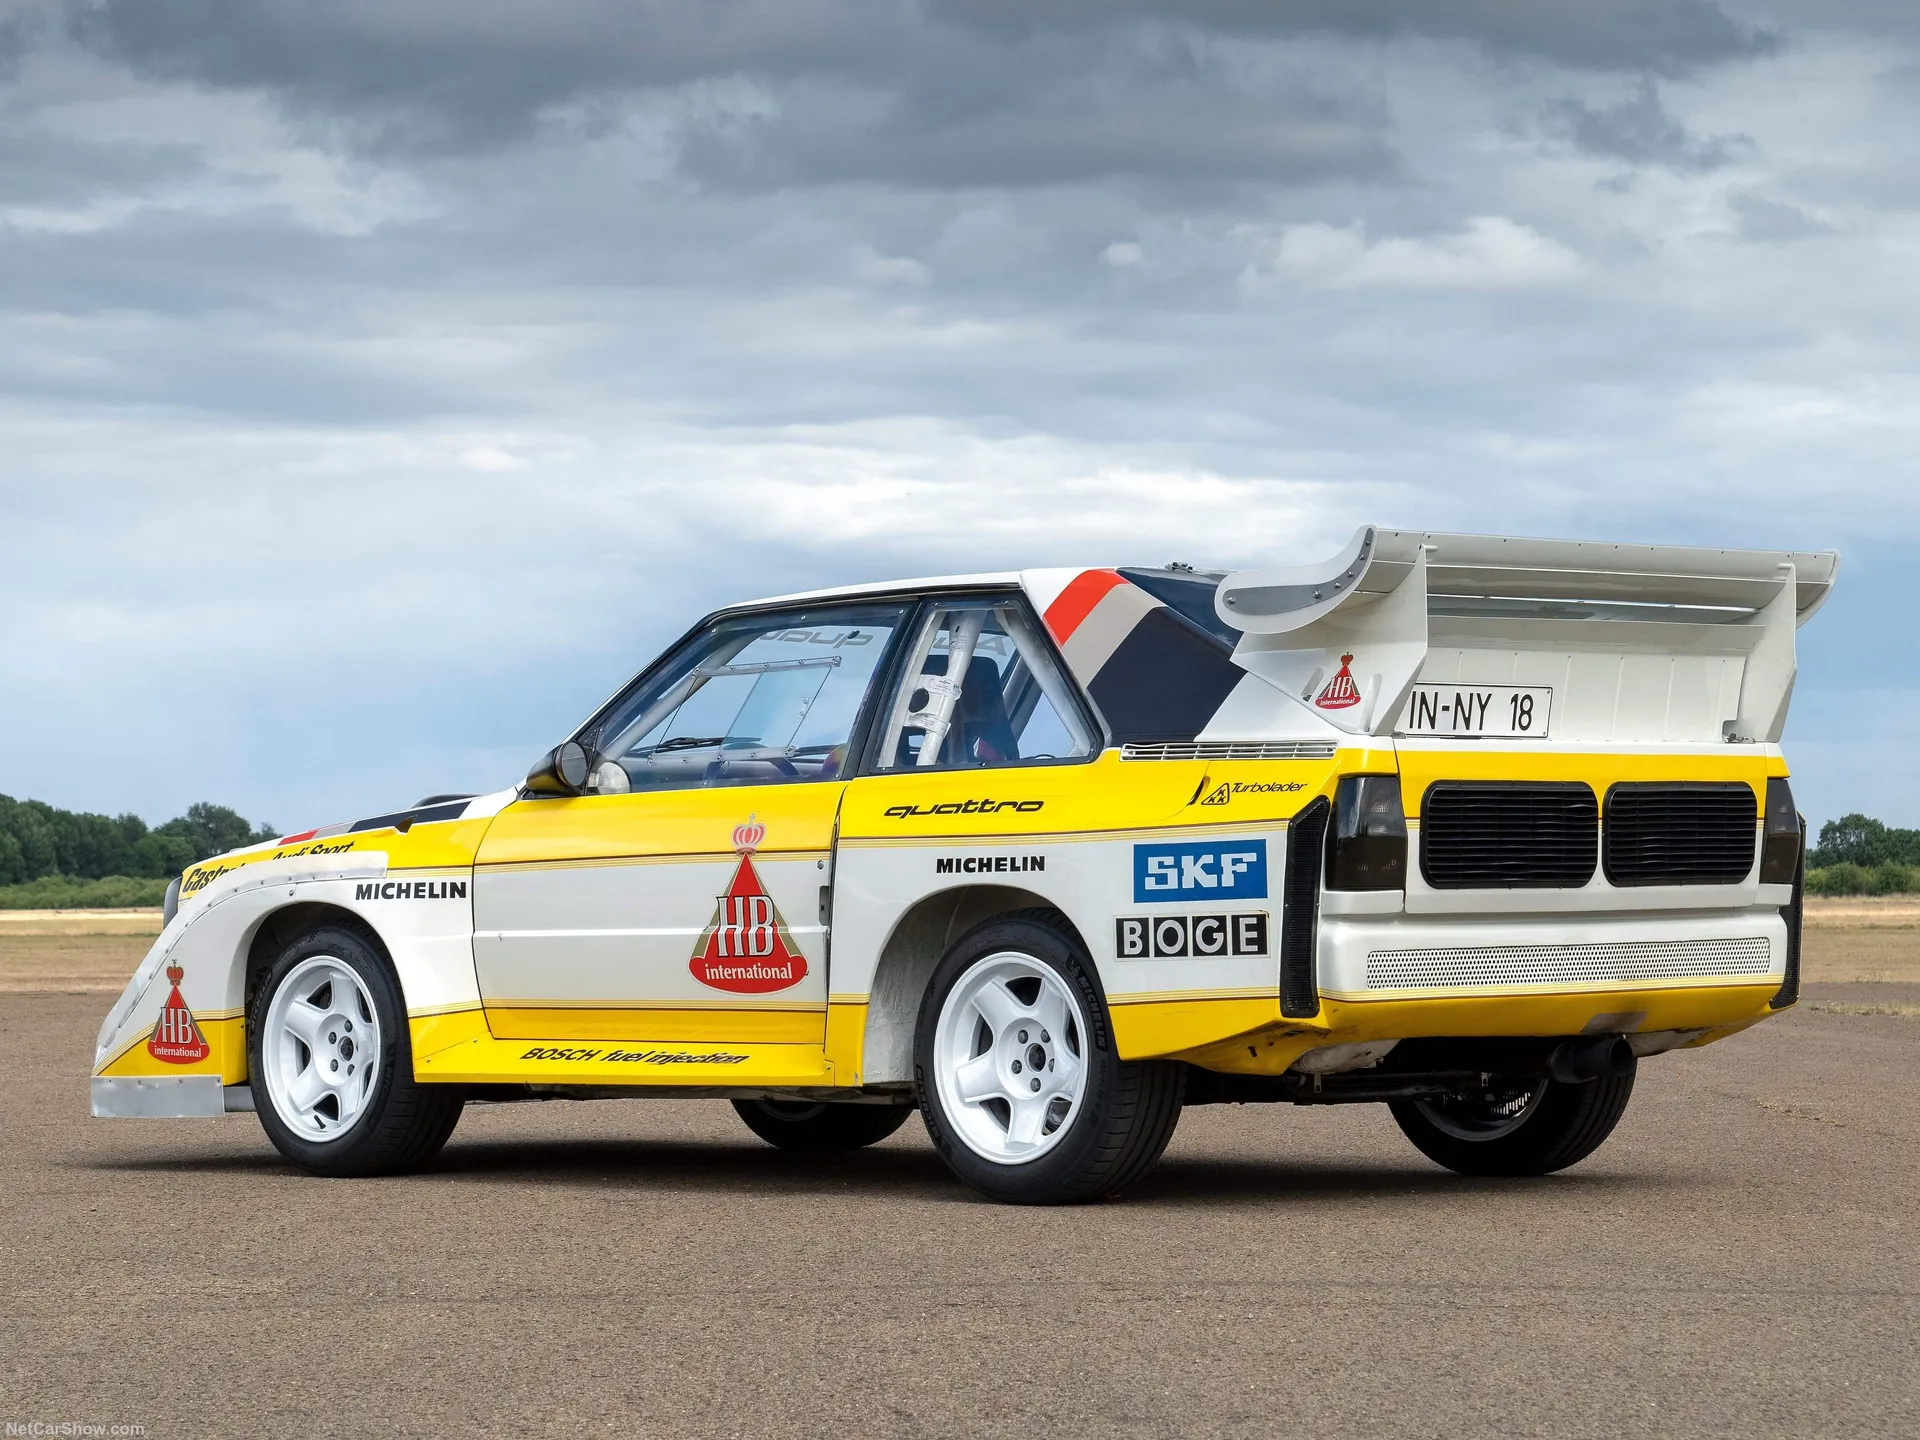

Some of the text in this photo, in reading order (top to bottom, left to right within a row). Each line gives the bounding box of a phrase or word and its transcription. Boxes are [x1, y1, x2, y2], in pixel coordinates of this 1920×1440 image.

[1328, 676, 1353, 698] HB
[1320, 697, 1355, 706] international
[1409, 690, 1534, 731] IN-NY 18
[1231, 781, 1308, 793] Turbolader
[883, 798, 1045, 820] quattro
[936, 855, 1046, 873] MICHELIN
[1144, 852, 1258, 891] SKF
[355, 881, 467, 901] MICHELIN
[715, 895, 775, 958] HB
[1123, 917, 1259, 956] BOGE
[704, 961, 793, 980] international
[1078, 974, 1107, 1049] MICHELIN
[160, 1006, 194, 1044] HB
[153, 1044, 202, 1058] international
[519, 1047, 751, 1065] BOSCH fuel injection
